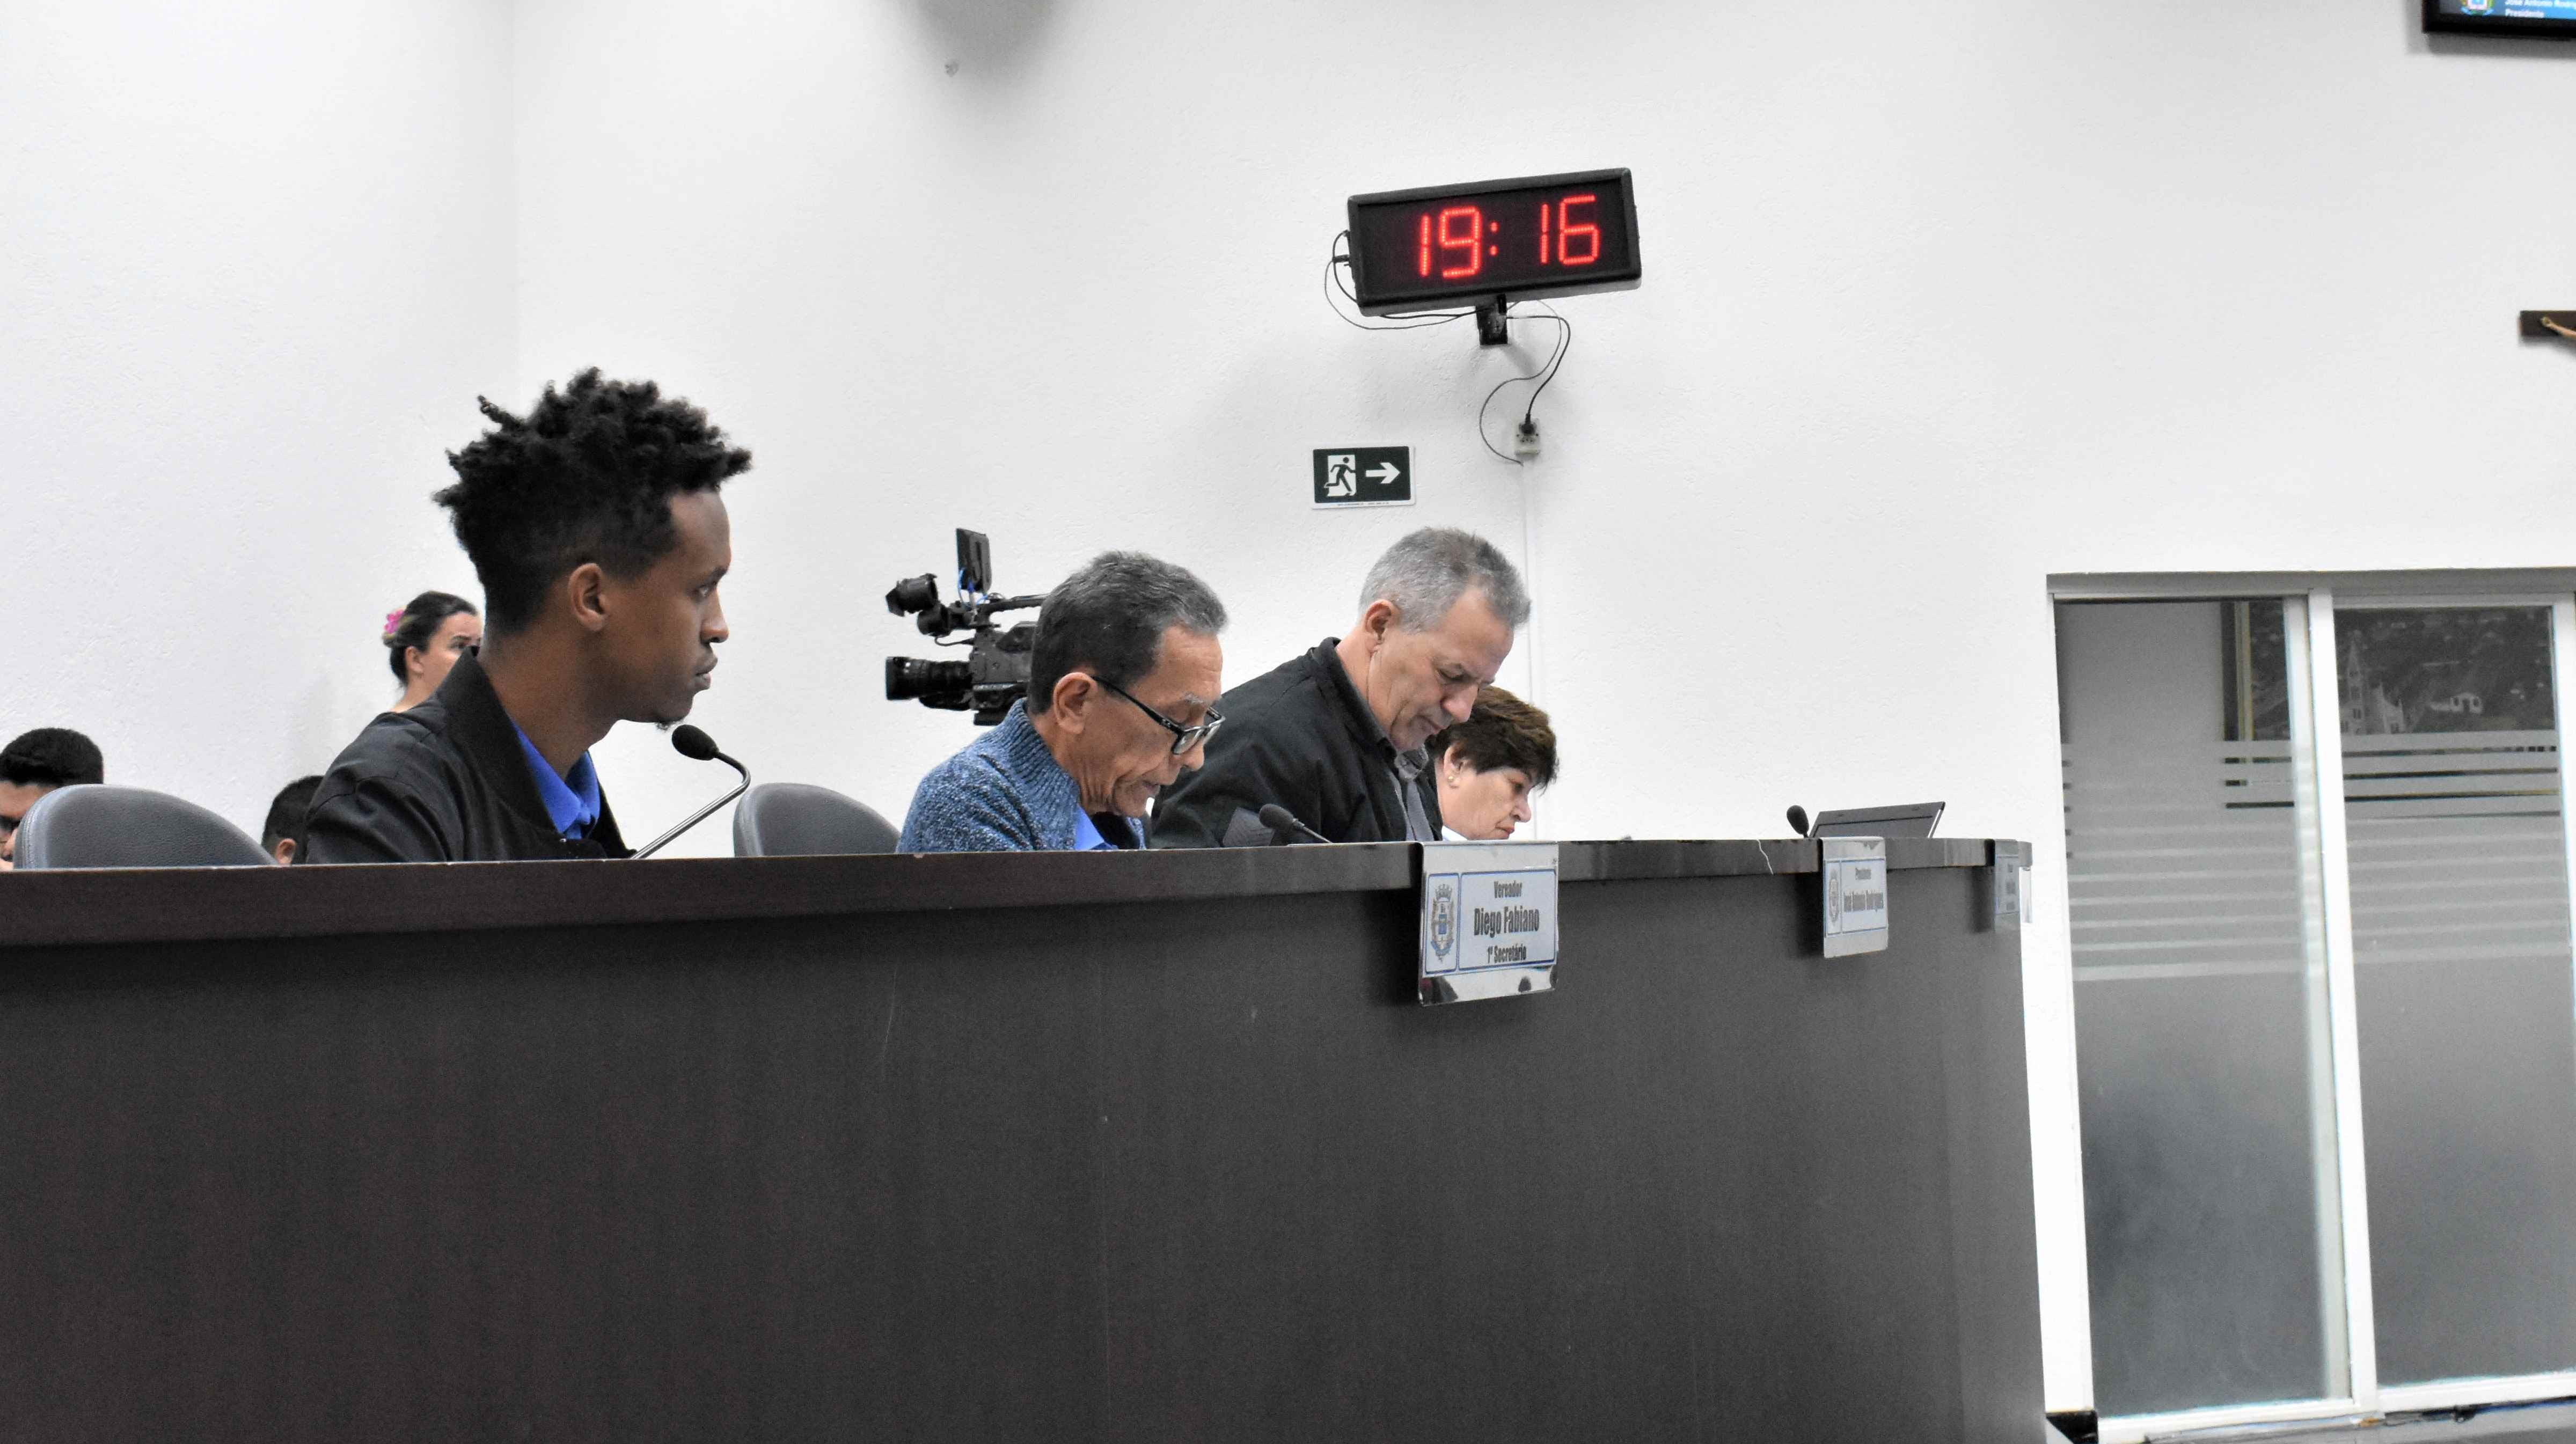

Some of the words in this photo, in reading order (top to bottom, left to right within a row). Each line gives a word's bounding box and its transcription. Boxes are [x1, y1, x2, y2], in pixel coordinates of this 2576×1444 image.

[1494, 880, 1523, 898] Vereador
[1474, 907, 1502, 938] Diego
[1504, 906, 1540, 934] Fabiano
[1494, 943, 1527, 963] Secretário
